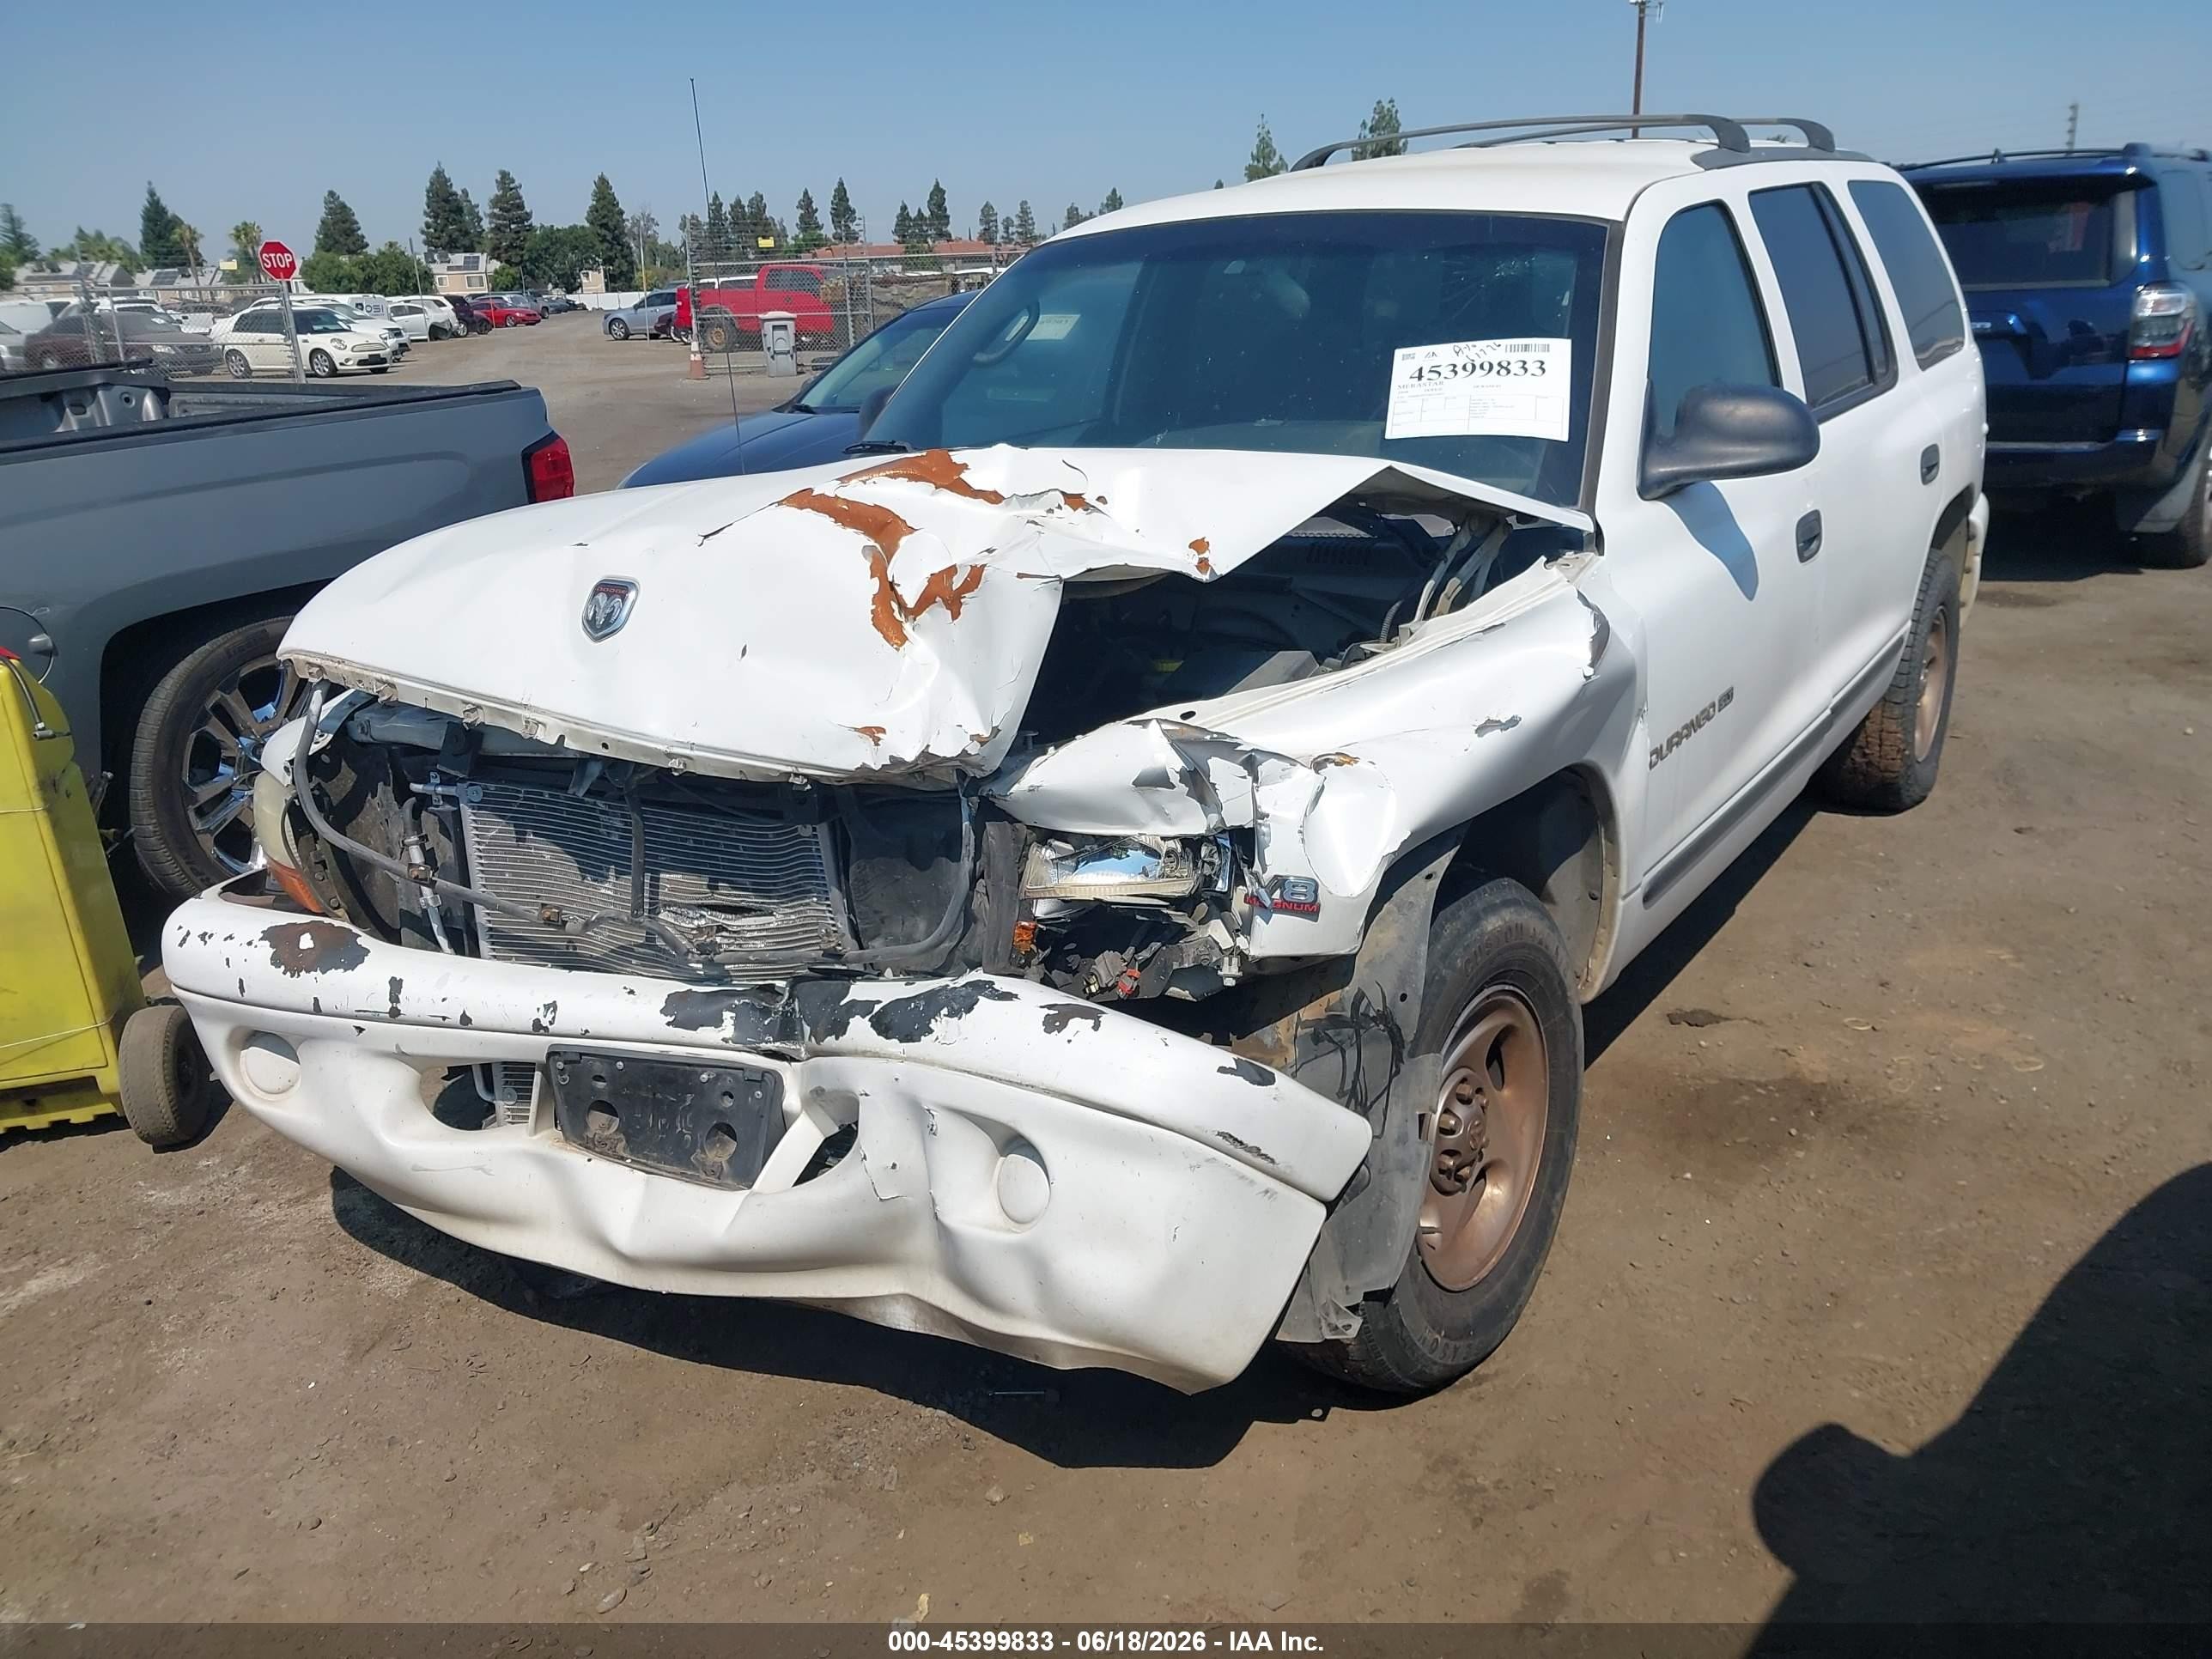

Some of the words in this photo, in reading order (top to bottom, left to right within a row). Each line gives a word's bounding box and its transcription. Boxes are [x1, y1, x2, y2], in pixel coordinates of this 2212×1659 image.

[262, 252, 293, 269] STOP
[1409, 360, 1547, 382] 45399833
[1649, 701, 1716, 771] DURANGO
